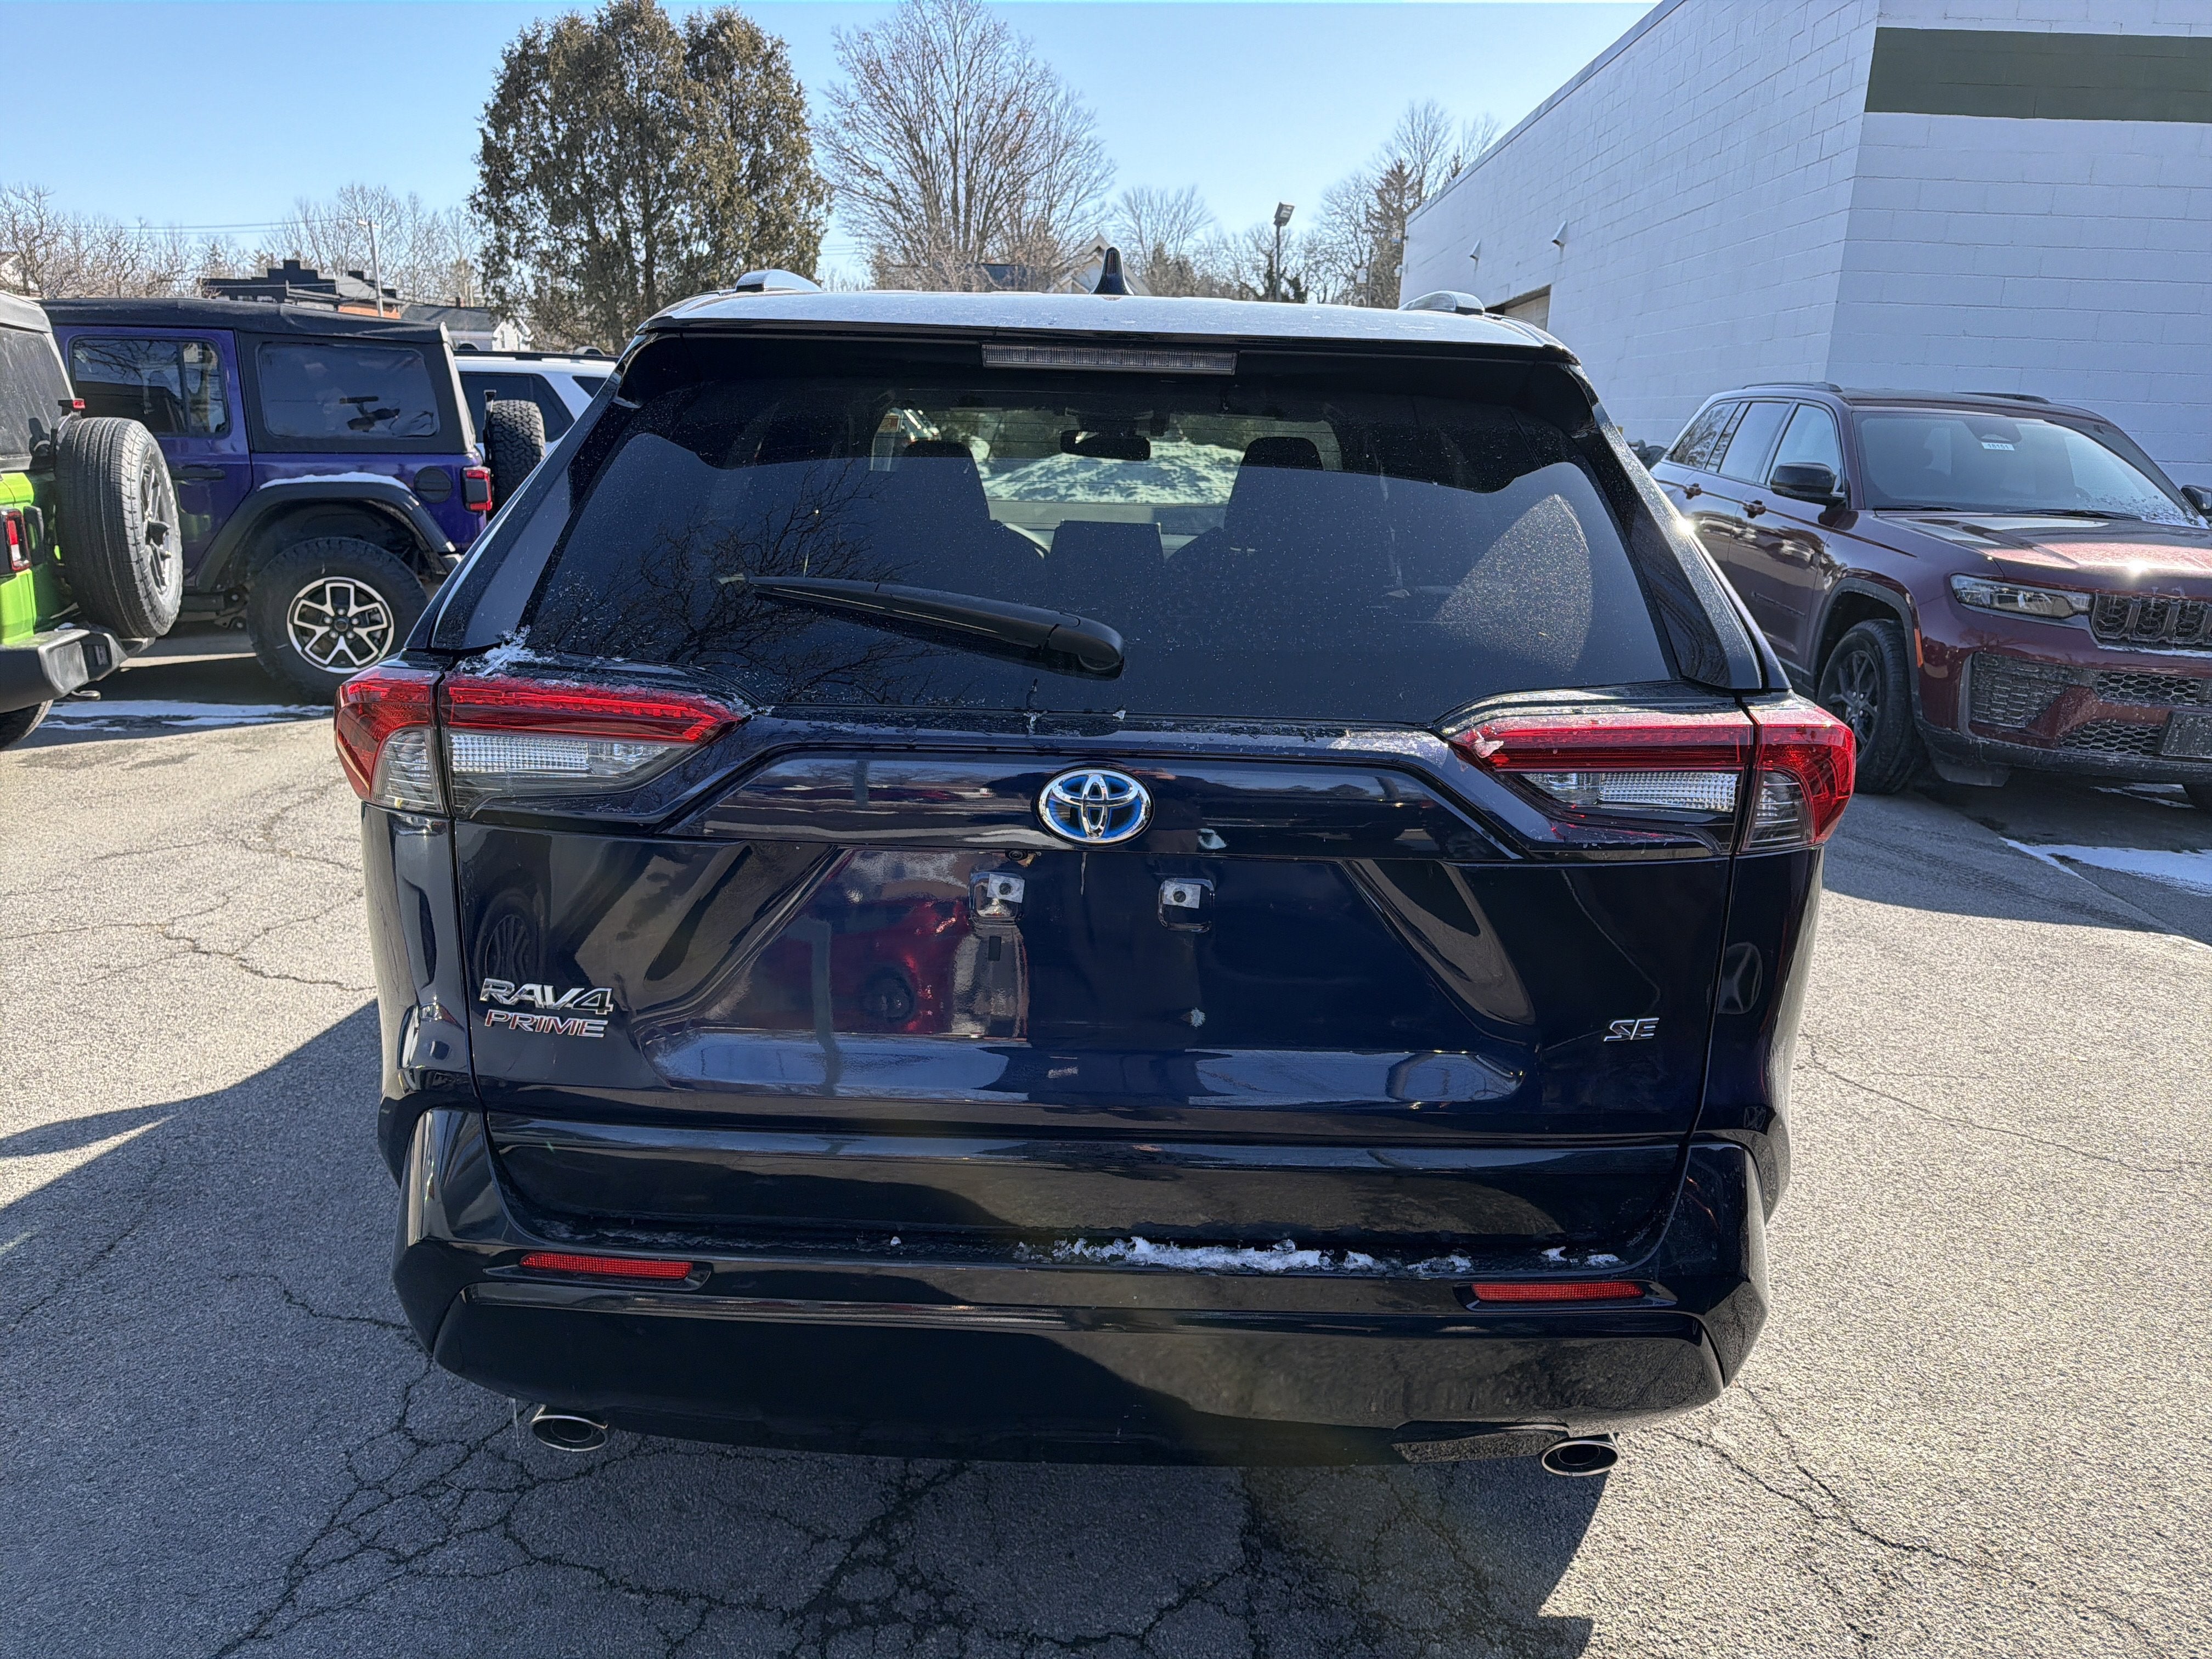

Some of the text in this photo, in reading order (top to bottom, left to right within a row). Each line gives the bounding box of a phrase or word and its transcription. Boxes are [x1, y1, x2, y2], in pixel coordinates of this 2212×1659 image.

[479, 978, 613, 1015] RAV4
[484, 1009, 608, 1037] PRIME
[1604, 1018, 1660, 1042] SE
